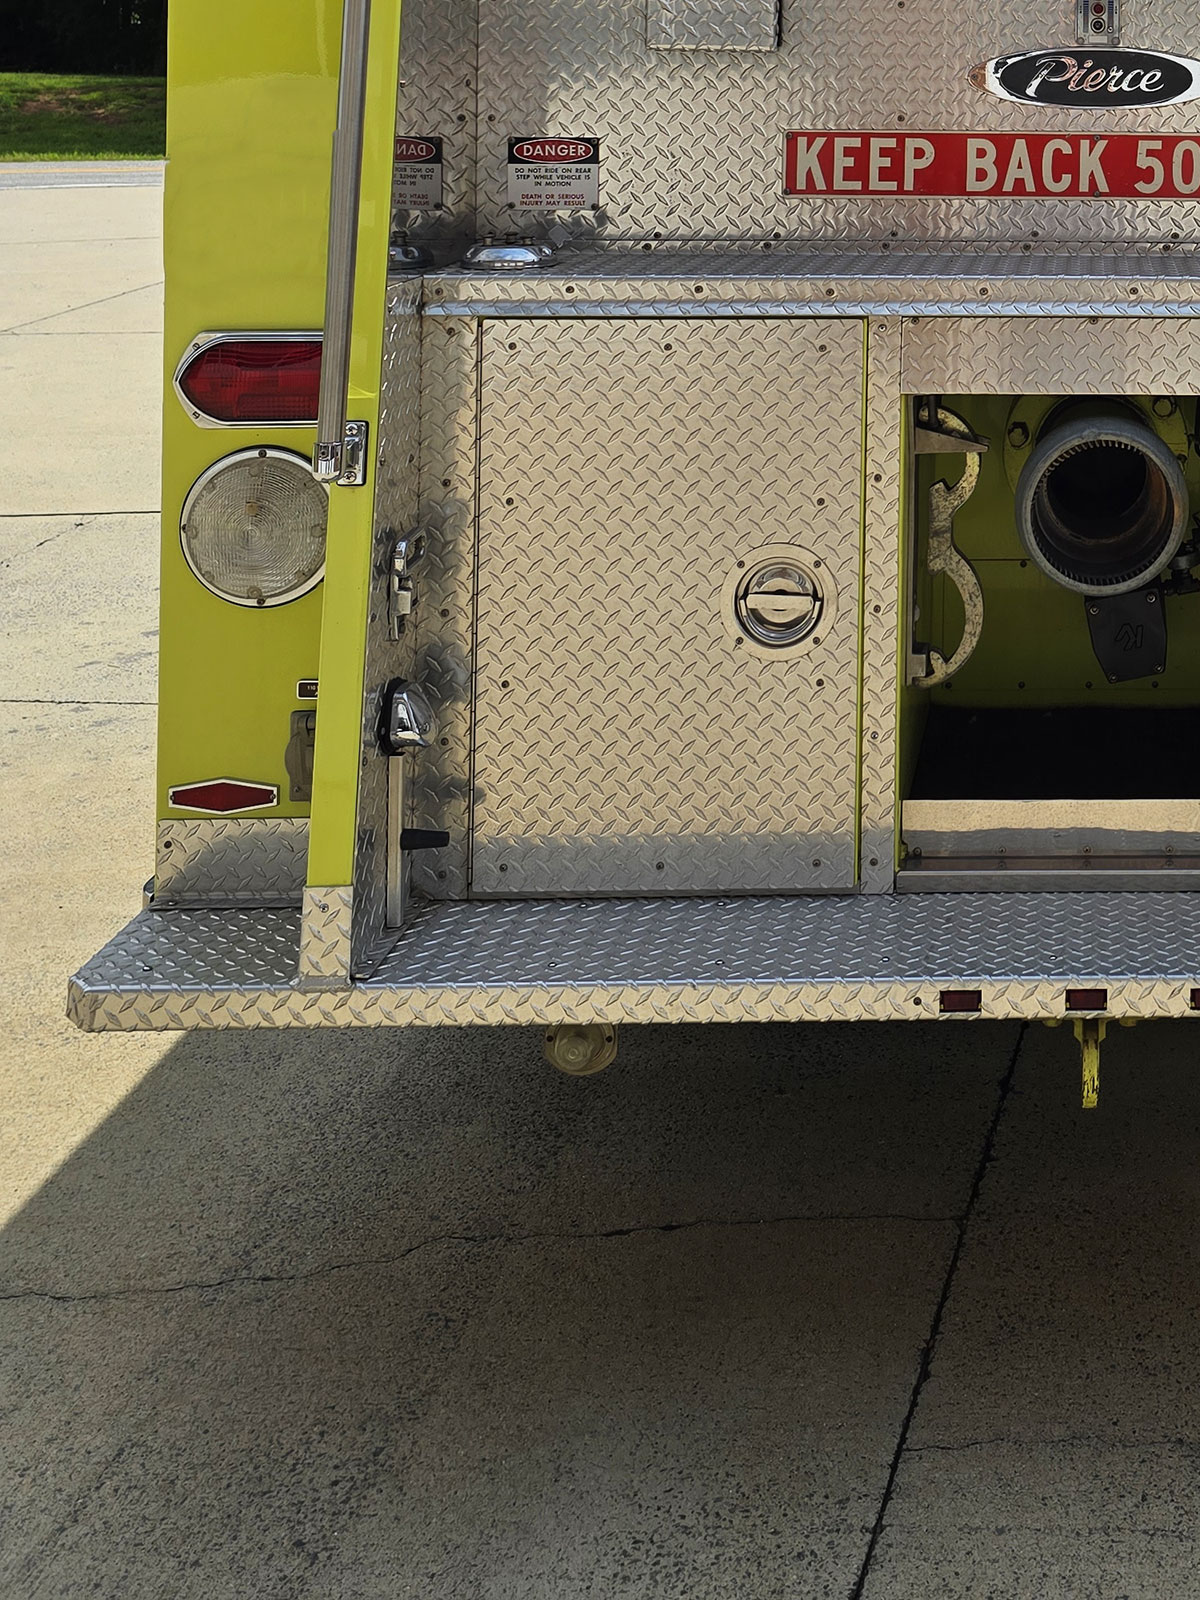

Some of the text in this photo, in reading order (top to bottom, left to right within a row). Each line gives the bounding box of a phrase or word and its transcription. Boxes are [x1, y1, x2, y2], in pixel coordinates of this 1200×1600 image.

[1025, 56, 1165, 97] Pierce
[523, 145, 586, 156] DANGER
[795, 137, 936, 190] KEEP
[965, 138, 1108, 193] BACK
